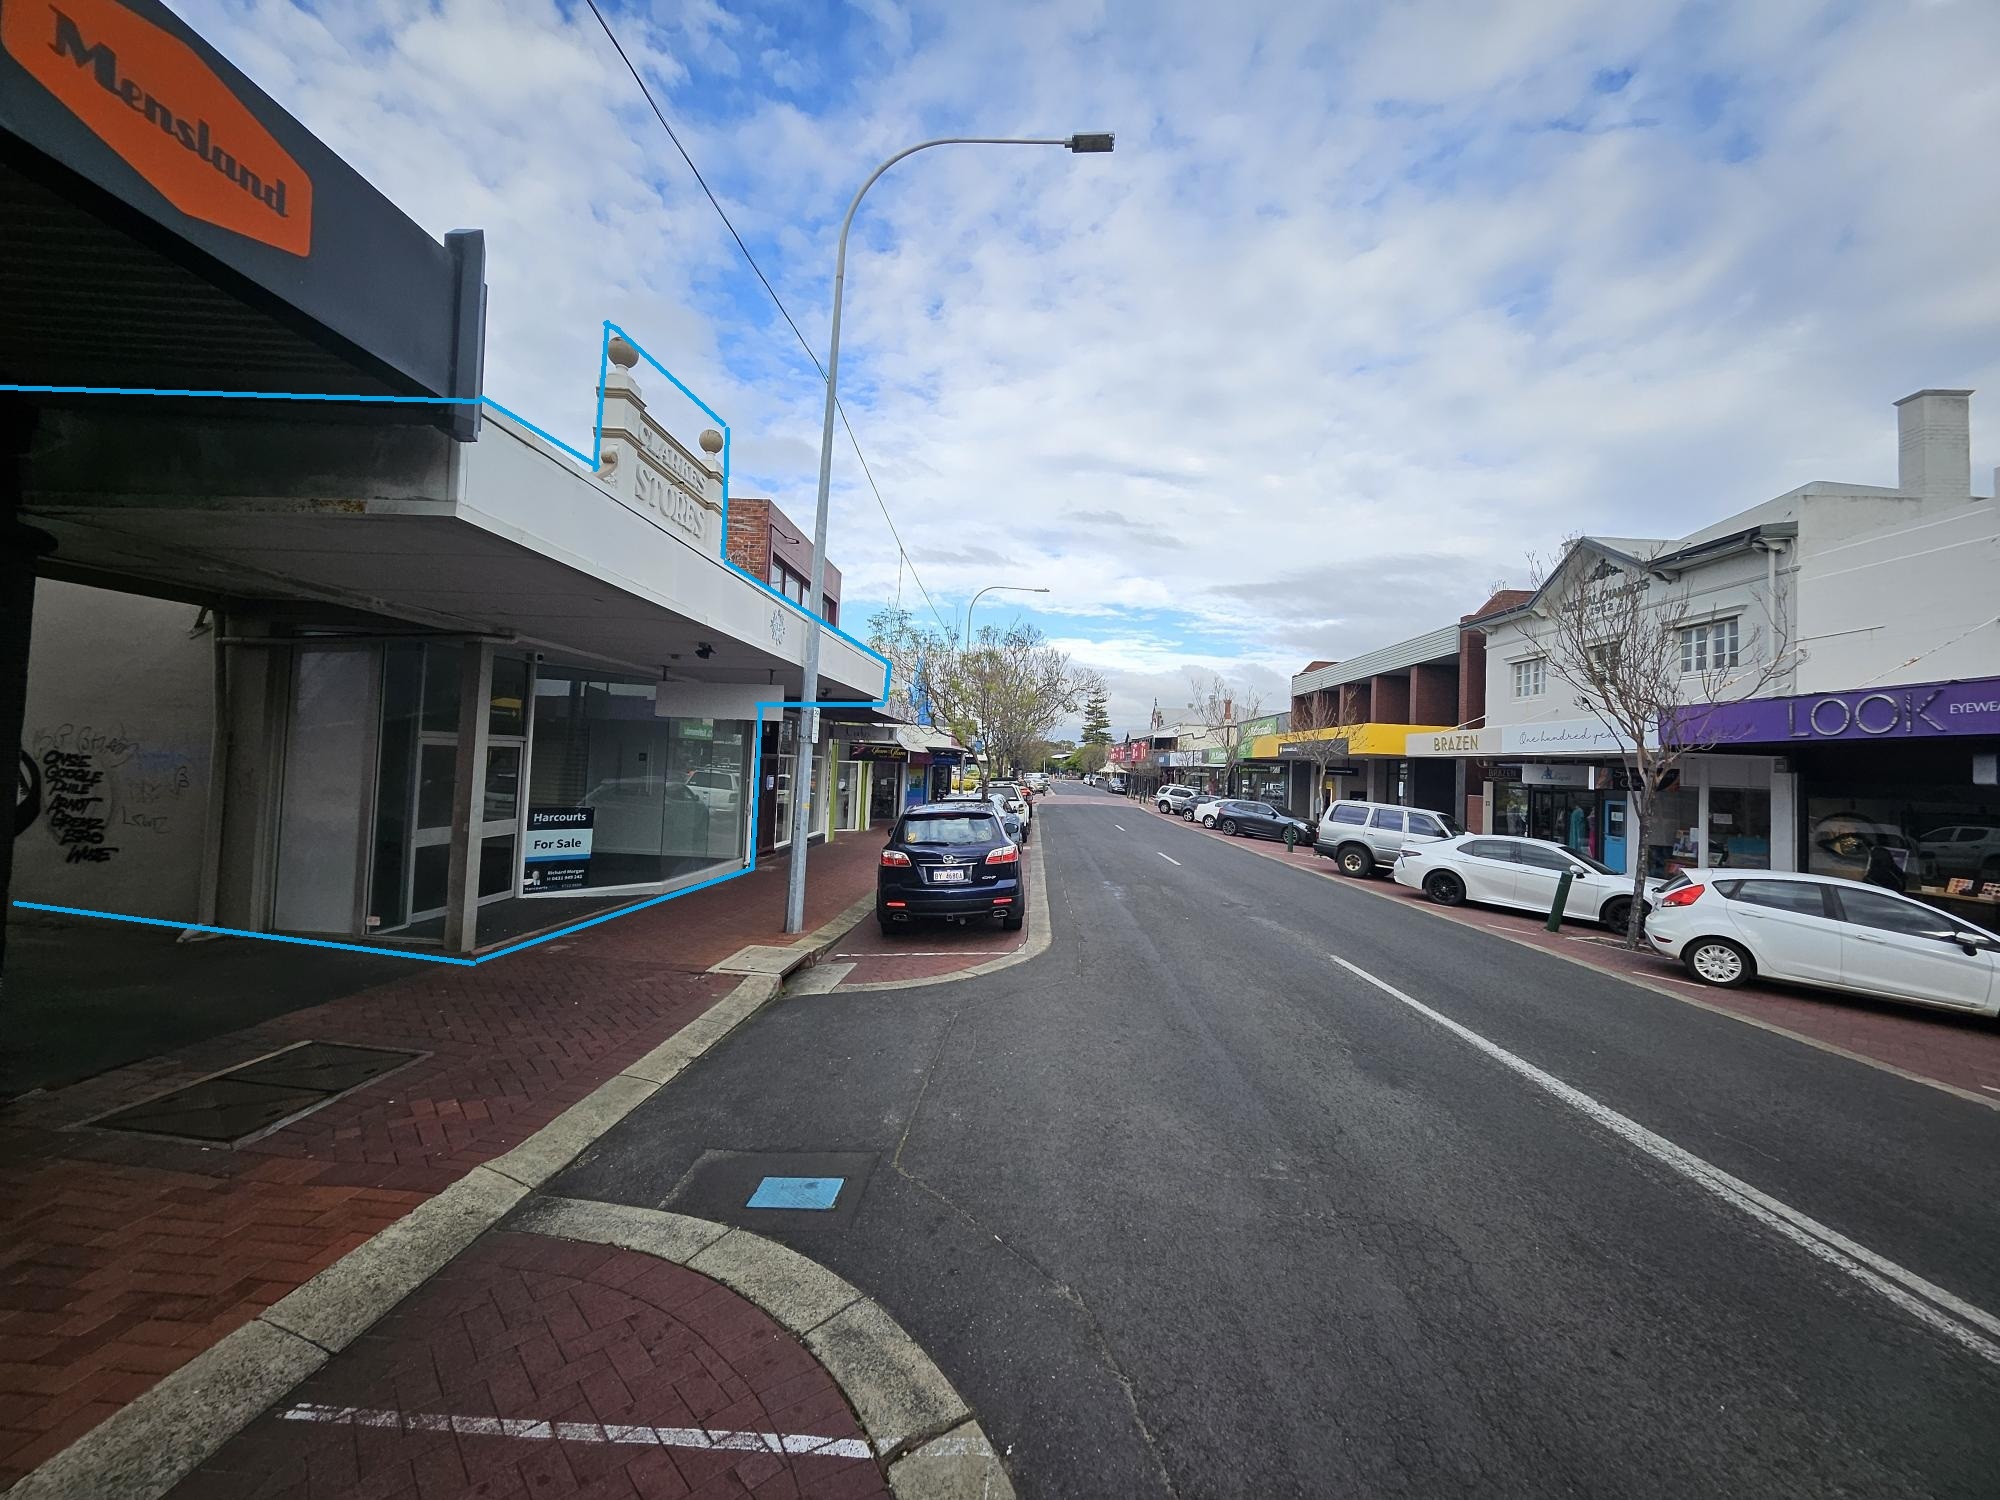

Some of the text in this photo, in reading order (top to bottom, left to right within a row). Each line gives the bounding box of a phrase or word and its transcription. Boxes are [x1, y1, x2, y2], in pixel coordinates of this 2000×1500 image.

[48, 4, 289, 218] Mensland
[635, 464, 704, 540] STORES
[1789, 690, 2000, 737] LOOK EYEWE
[1434, 735, 1479, 751] BRAZEN
[1519, 731, 1538, 745] One
[1540, 728, 1590, 742] hundred
[45, 765, 104, 784] GOOGLE
[1488, 768, 1517, 778] BRAZEN
[534, 813, 586, 823] Harcourts
[534, 839, 581, 849] For Sale
